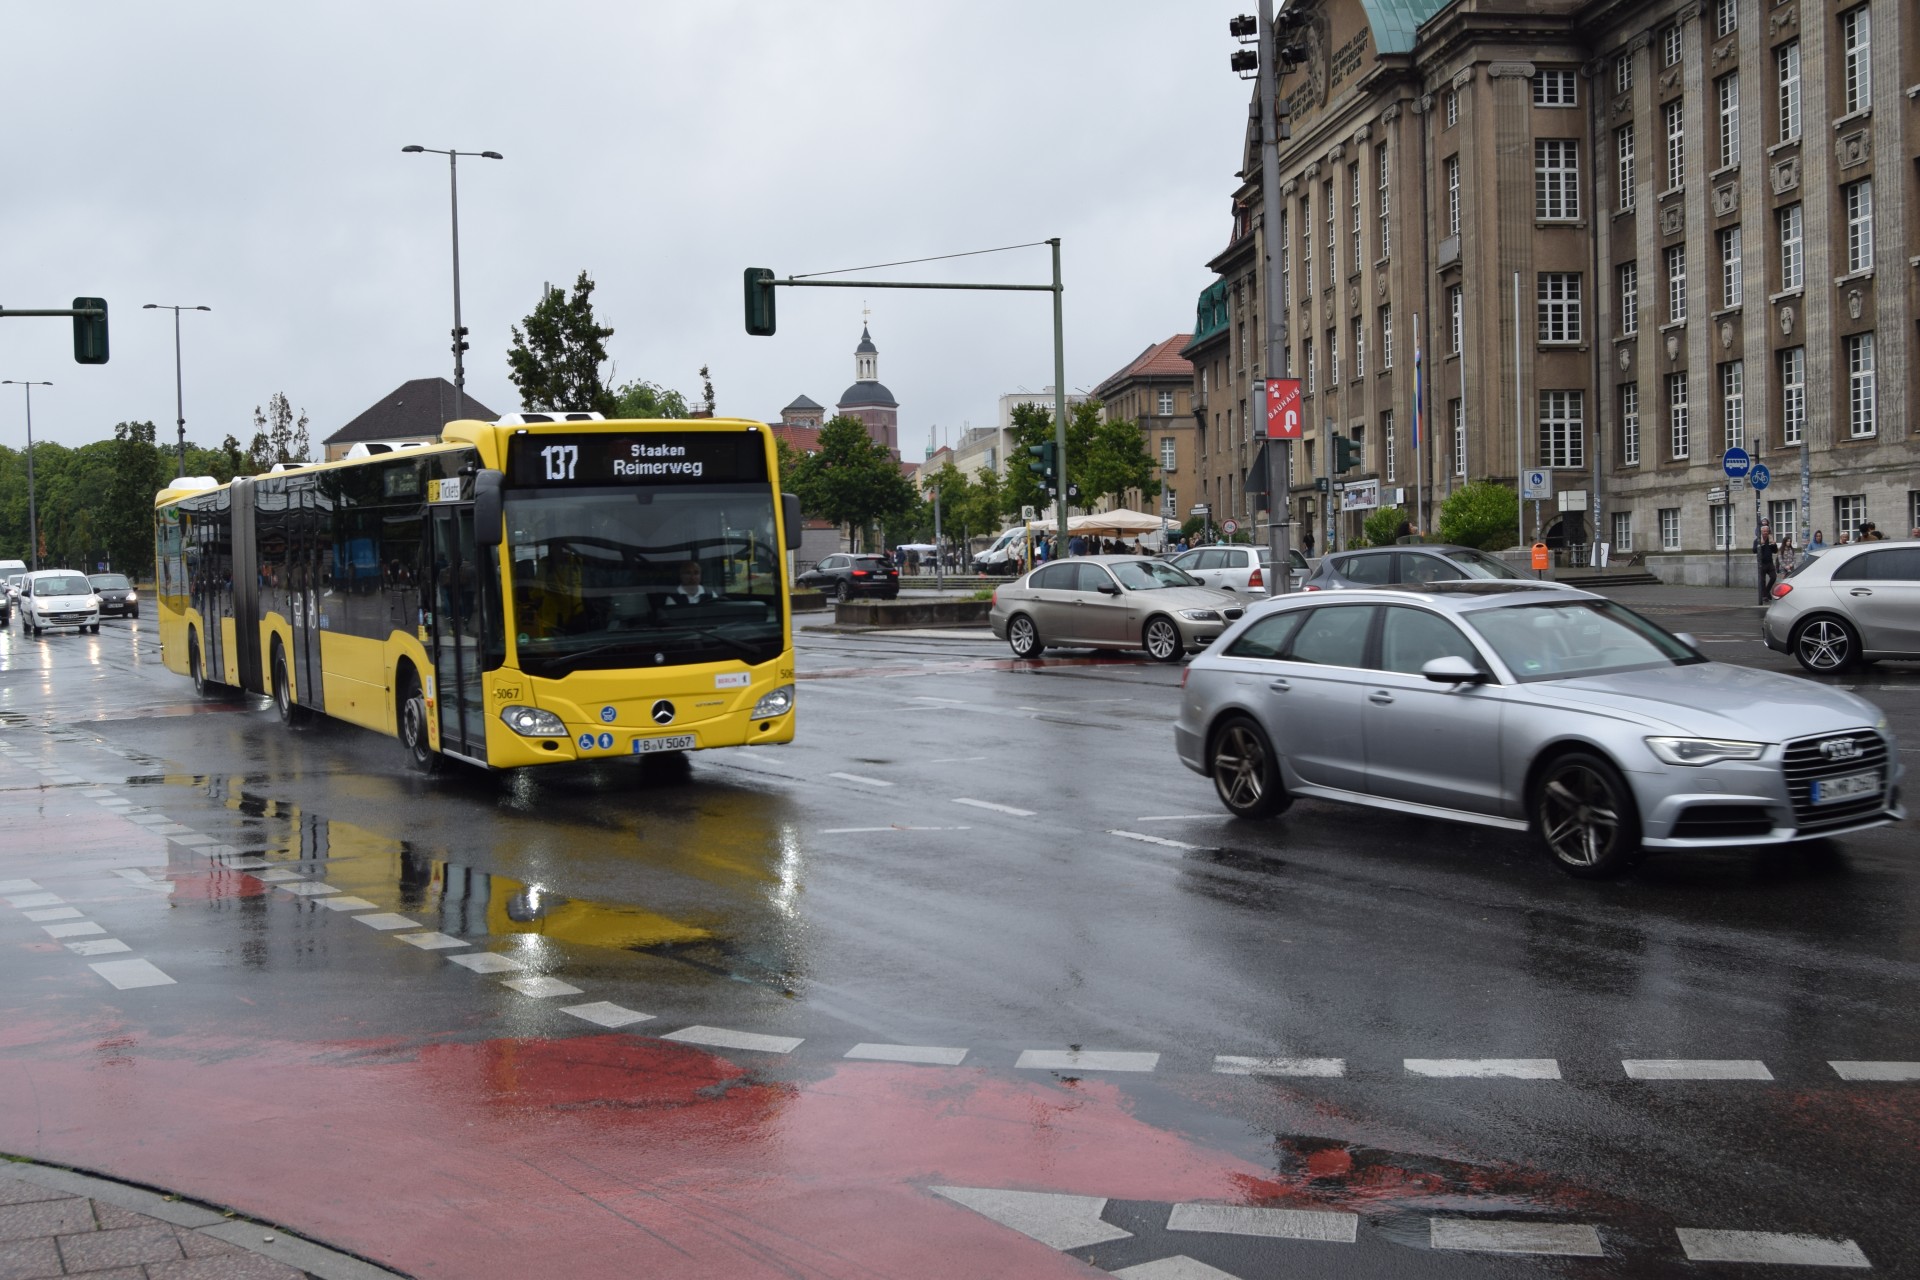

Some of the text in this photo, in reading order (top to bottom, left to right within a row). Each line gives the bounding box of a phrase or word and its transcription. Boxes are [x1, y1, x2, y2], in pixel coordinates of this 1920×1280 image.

[1268, 387, 1300, 420] BAUHAUS
[631, 443, 686, 457] Staaken
[541, 444, 579, 480] 137
[613, 459, 703, 477] Reimerweg
[441, 480, 459, 499] Tickets
[496, 688, 519, 699] 5067
[643, 736, 691, 751] B V 5067
